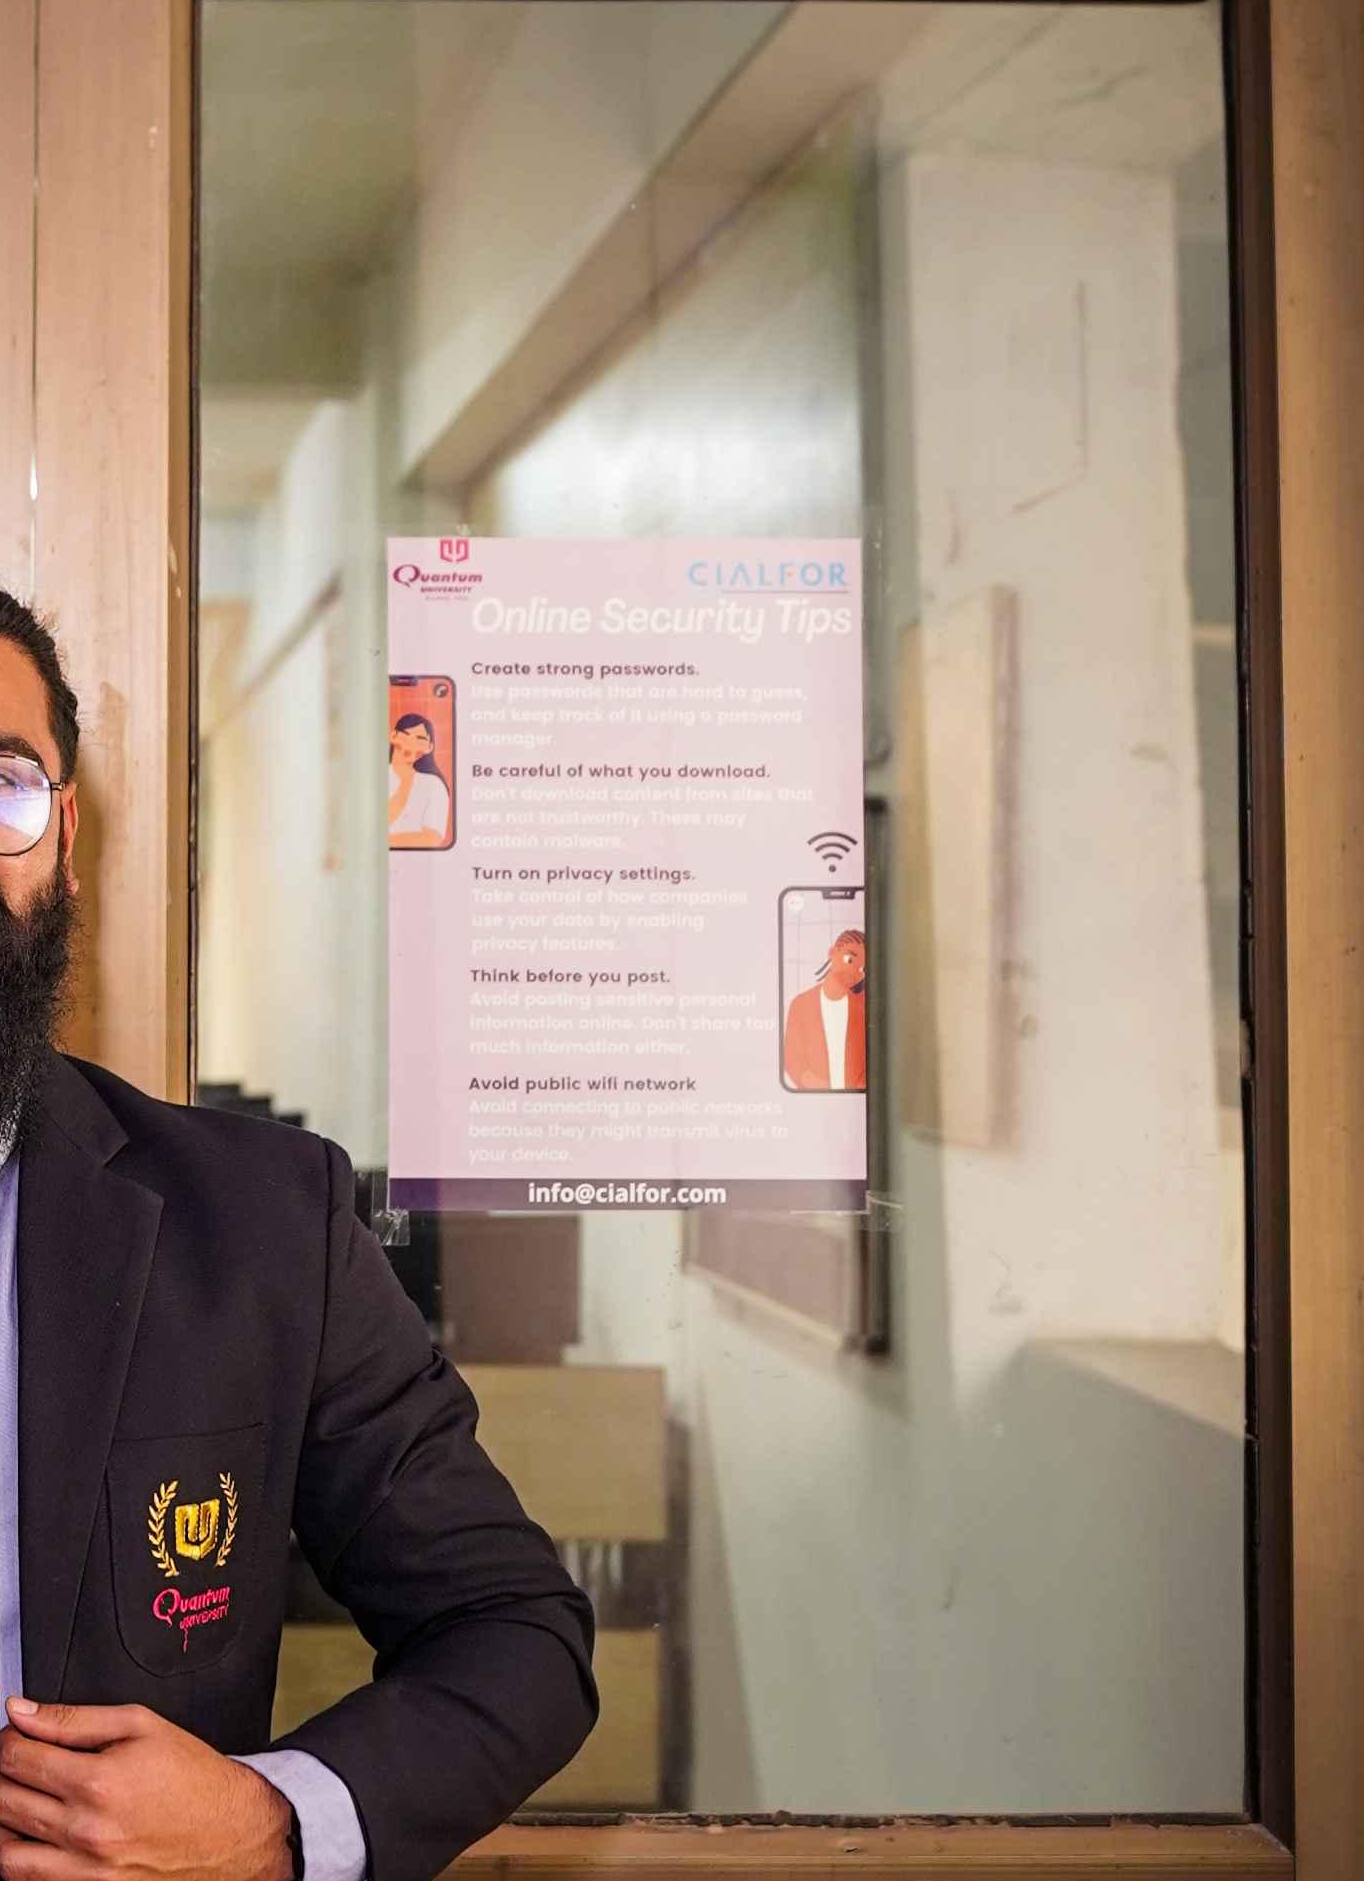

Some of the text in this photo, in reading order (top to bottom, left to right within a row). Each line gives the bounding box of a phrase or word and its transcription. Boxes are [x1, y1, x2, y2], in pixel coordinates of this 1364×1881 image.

[393, 565, 482, 588] Quantum
[688, 562, 846, 586] CIALFOR
[471, 598, 852, 644] Online Security Tips
[472, 662, 700, 679] Create strong passwords.
[471, 686, 503, 699] Use
[508, 685, 602, 704] passwords
[608, 685, 643, 699] that
[649, 687, 677, 699] are
[683, 685, 724, 699] hard
[729, 686, 746, 699] to
[471, 709, 504, 722] and
[511, 708, 555, 725] keep
[560, 708, 604, 721] track
[630, 709, 642, 722] it
[647, 708, 696, 727] using
[700, 712, 712, 722] a
[717, 709, 803, 726] password
[472, 733, 556, 749] manager.
[472, 764, 770, 782] Be careful of what you download.
[472, 786, 812, 801] Don't download content from sites that
[471, 813, 501, 823] are
[506, 812, 536, 823] not
[652, 812, 700, 825] These
[707, 814, 746, 828] may
[471, 834, 537, 847] contain
[472, 866, 695, 884] Turn on privacy settings.
[472, 889, 748, 905] Take control of how companies
[472, 913, 704, 933] use your data by enabling
[472, 937, 537, 956] privacy
[471, 969, 670, 987] Think before you post.
[470, 992, 756, 1011] Avoid posting sensitive personal
[470, 1016, 572, 1030] information
[642, 1017, 687, 1030] Don't
[691, 1017, 740, 1030] share
[470, 1040, 520, 1054] much
[526, 1040, 629, 1054] information
[469, 1077, 696, 1094] Avoid public wifi network
[469, 1100, 783, 1119] Avoid connecting to public networks
[469, 1124, 788, 1140] because they might transmit virus to
[469, 1147, 572, 1166] your device.
[528, 1182, 726, 1204] info@cialfor.com
[152, 1586, 230, 1627] Quantum
